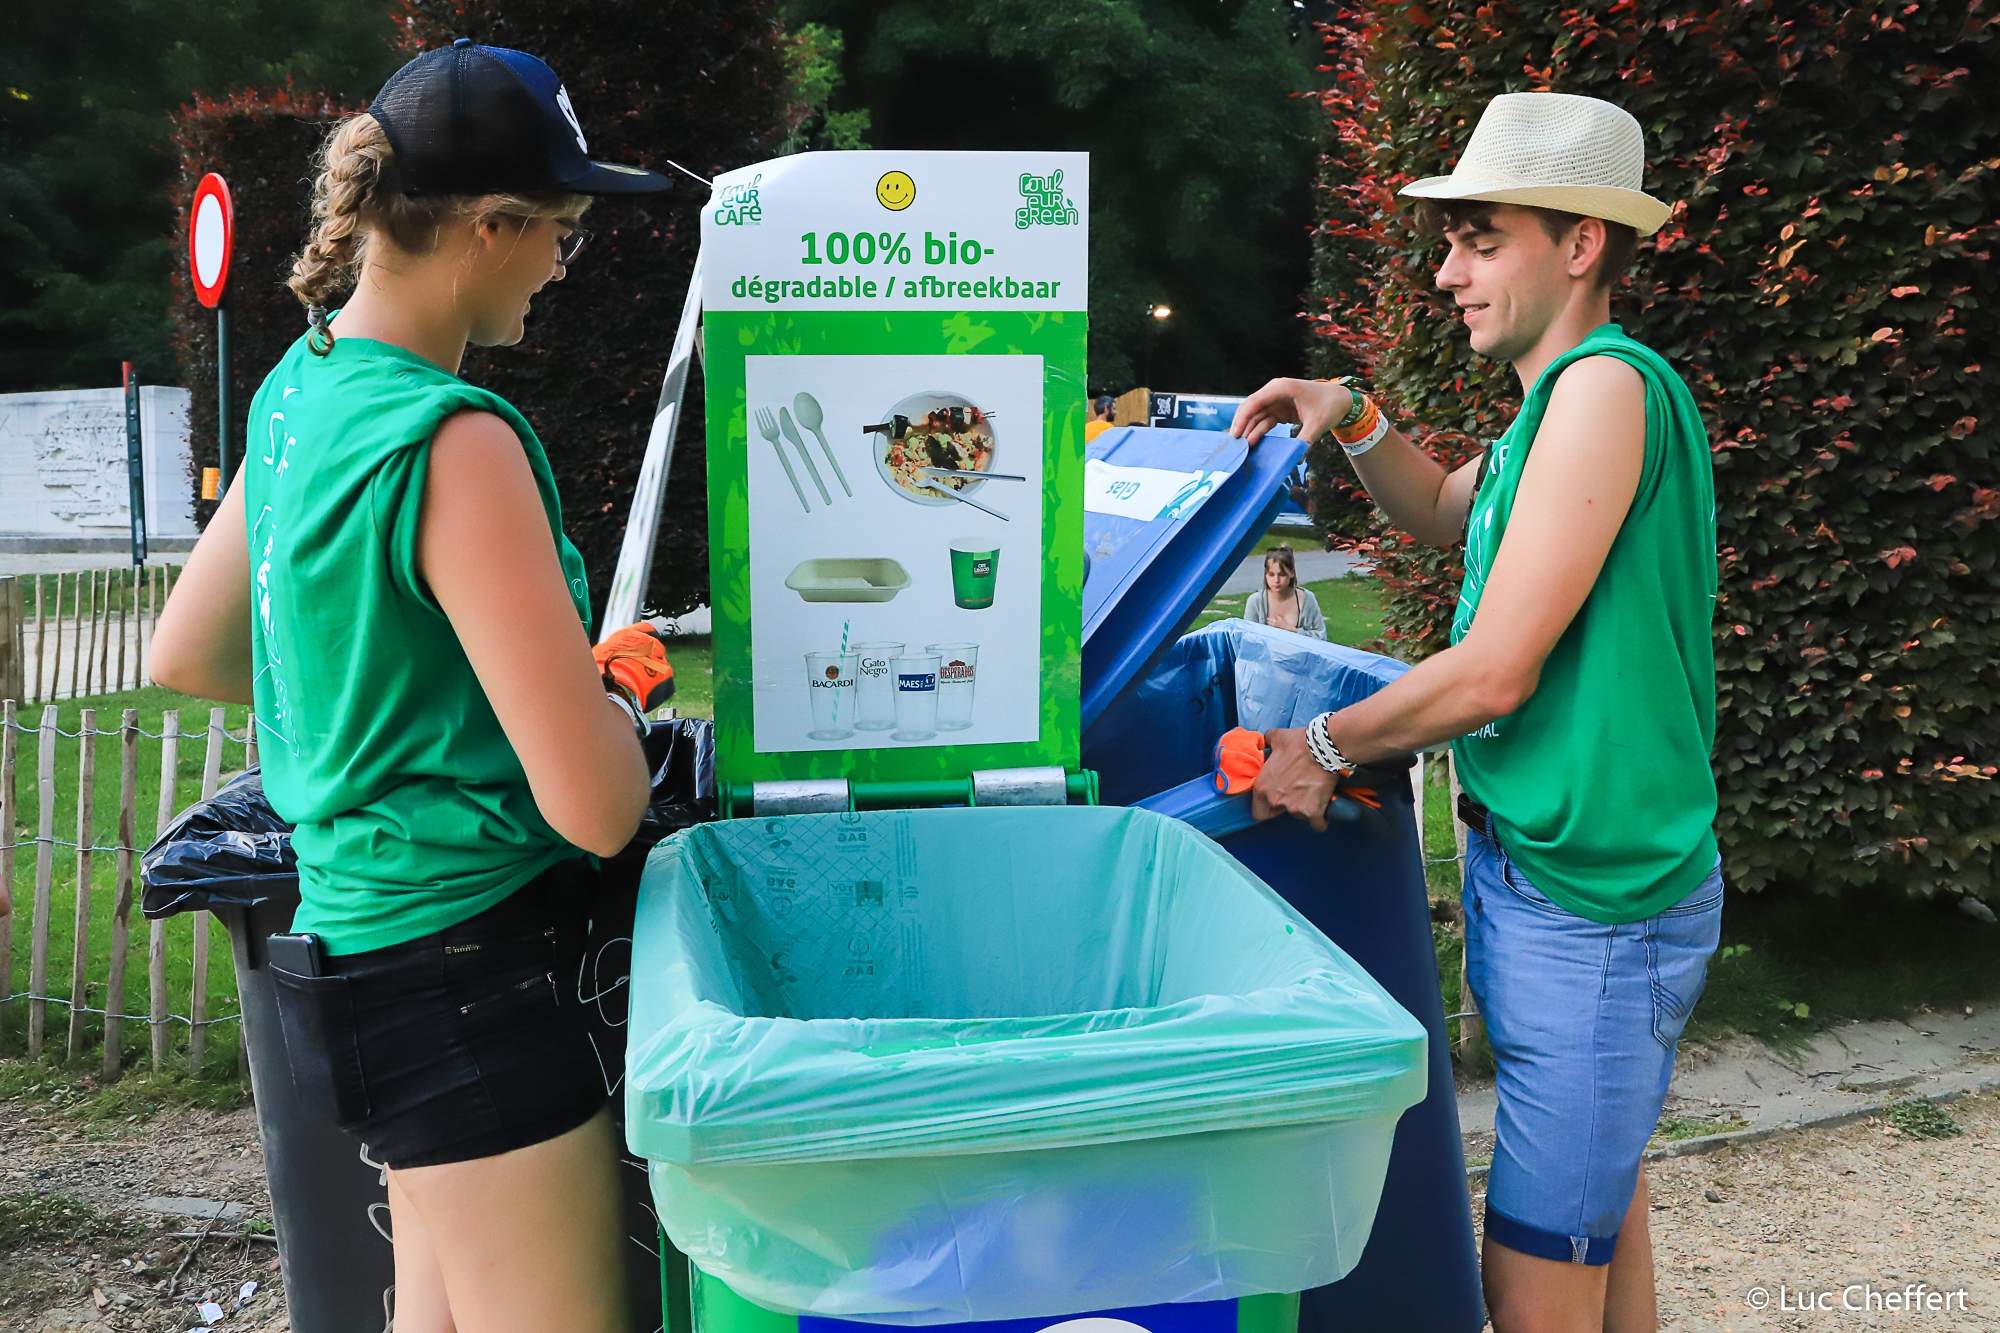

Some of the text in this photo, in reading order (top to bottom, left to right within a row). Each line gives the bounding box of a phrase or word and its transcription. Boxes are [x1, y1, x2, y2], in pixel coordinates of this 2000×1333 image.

[801, 231, 994, 265] 100% bio-
[731, 275, 877, 303] dégradable
[903, 275, 1061, 299] afbreekbaar
[861, 657, 886, 668] Gato
[860, 667, 888, 678] Negro
[812, 679, 854, 689] BACARDI
[899, 680, 920, 688] MAES
